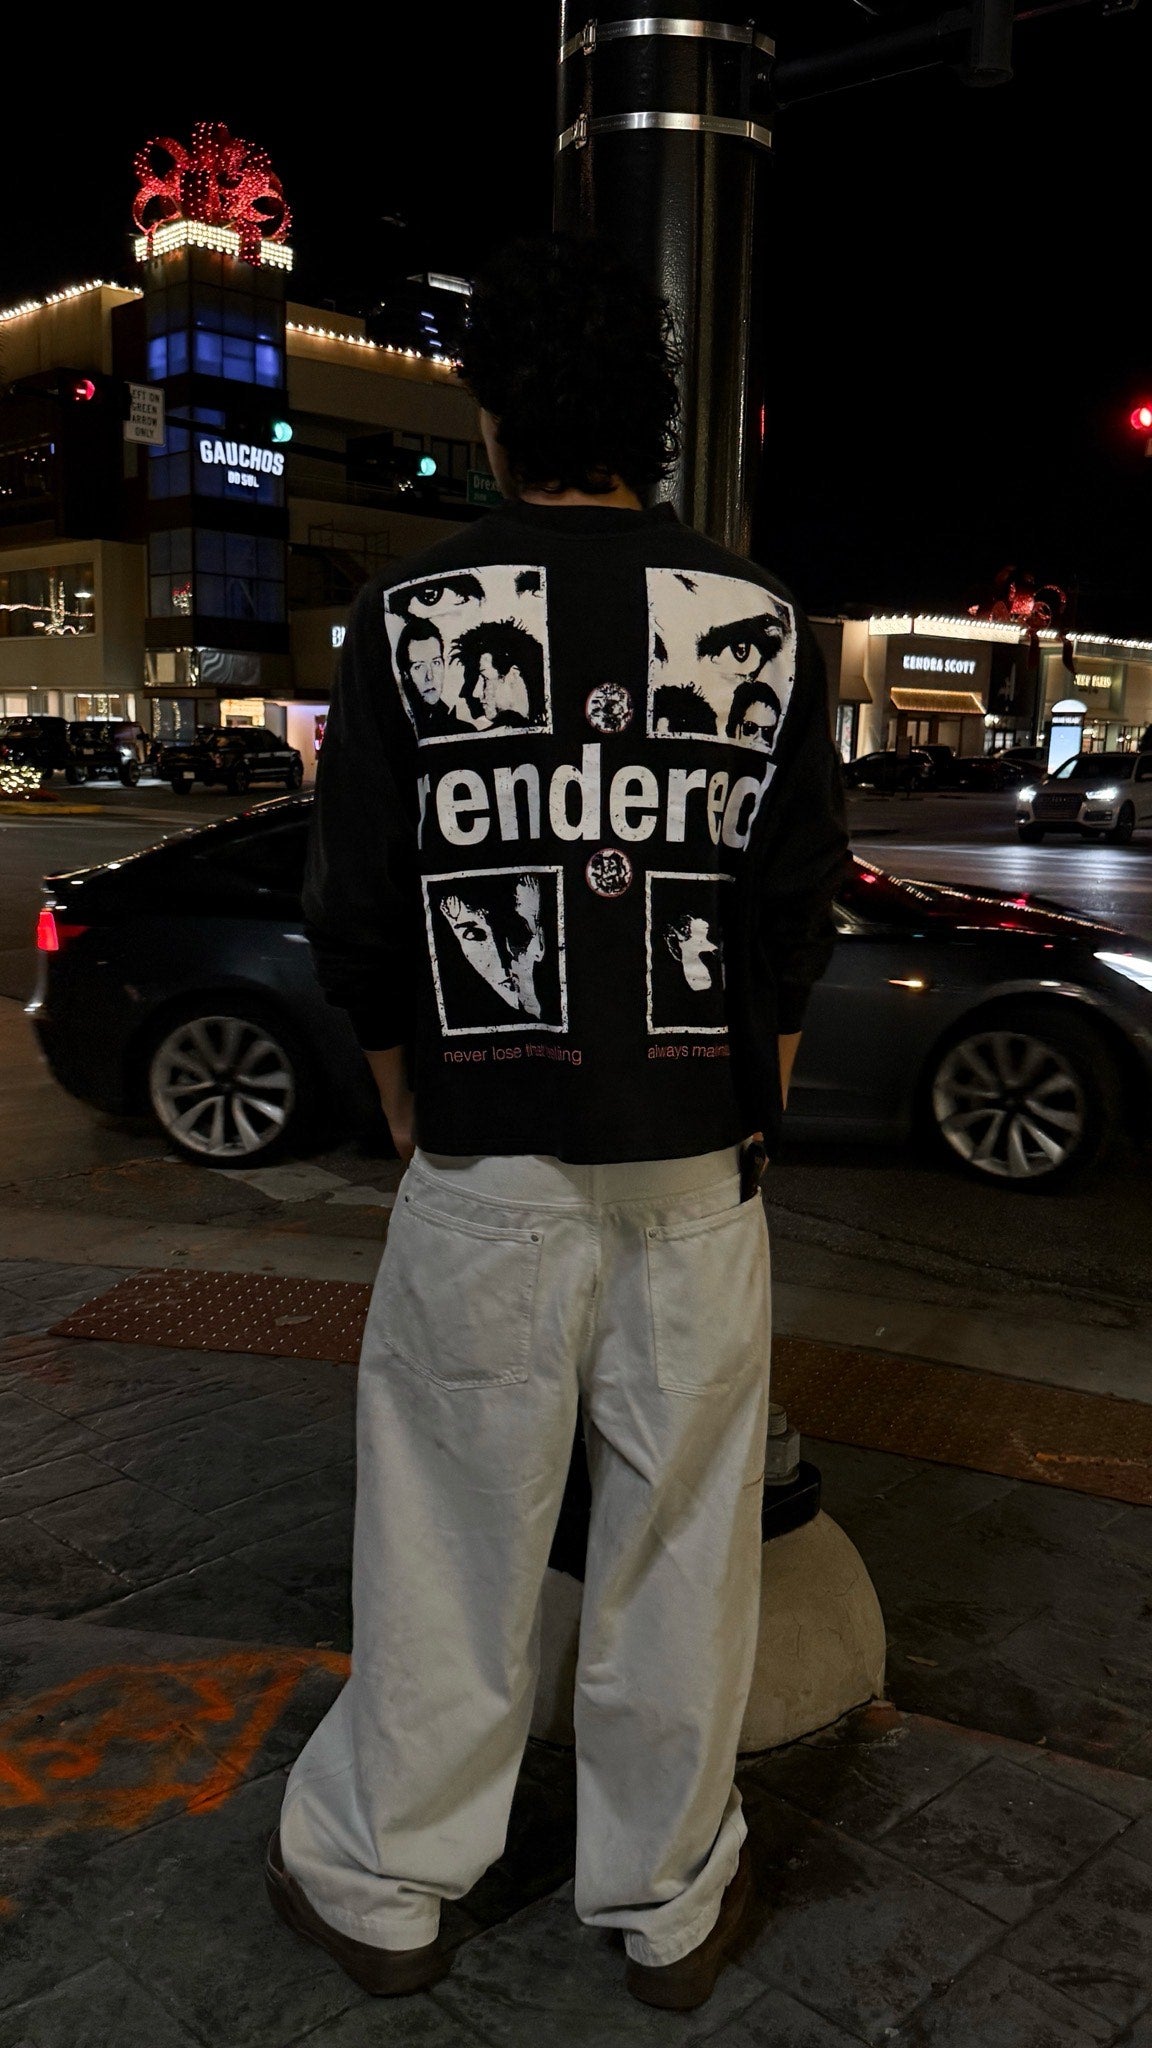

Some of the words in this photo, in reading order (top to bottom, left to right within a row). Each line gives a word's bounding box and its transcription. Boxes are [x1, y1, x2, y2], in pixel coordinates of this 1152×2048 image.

[132, 389, 146, 400] EFT
[149, 392, 160, 402] ON
[132, 414, 158, 426] ARROW
[135, 427, 154, 438] ONLY
[199, 439, 285, 476] GAUCHOS
[902, 654, 944, 672] KENDRA
[944, 658, 977, 675] SCOTT
[417, 742, 778, 852] rendered
[443, 1049, 488, 1063] never
[492, 1045, 522, 1061] lose
[647, 1044, 689, 1060] always
